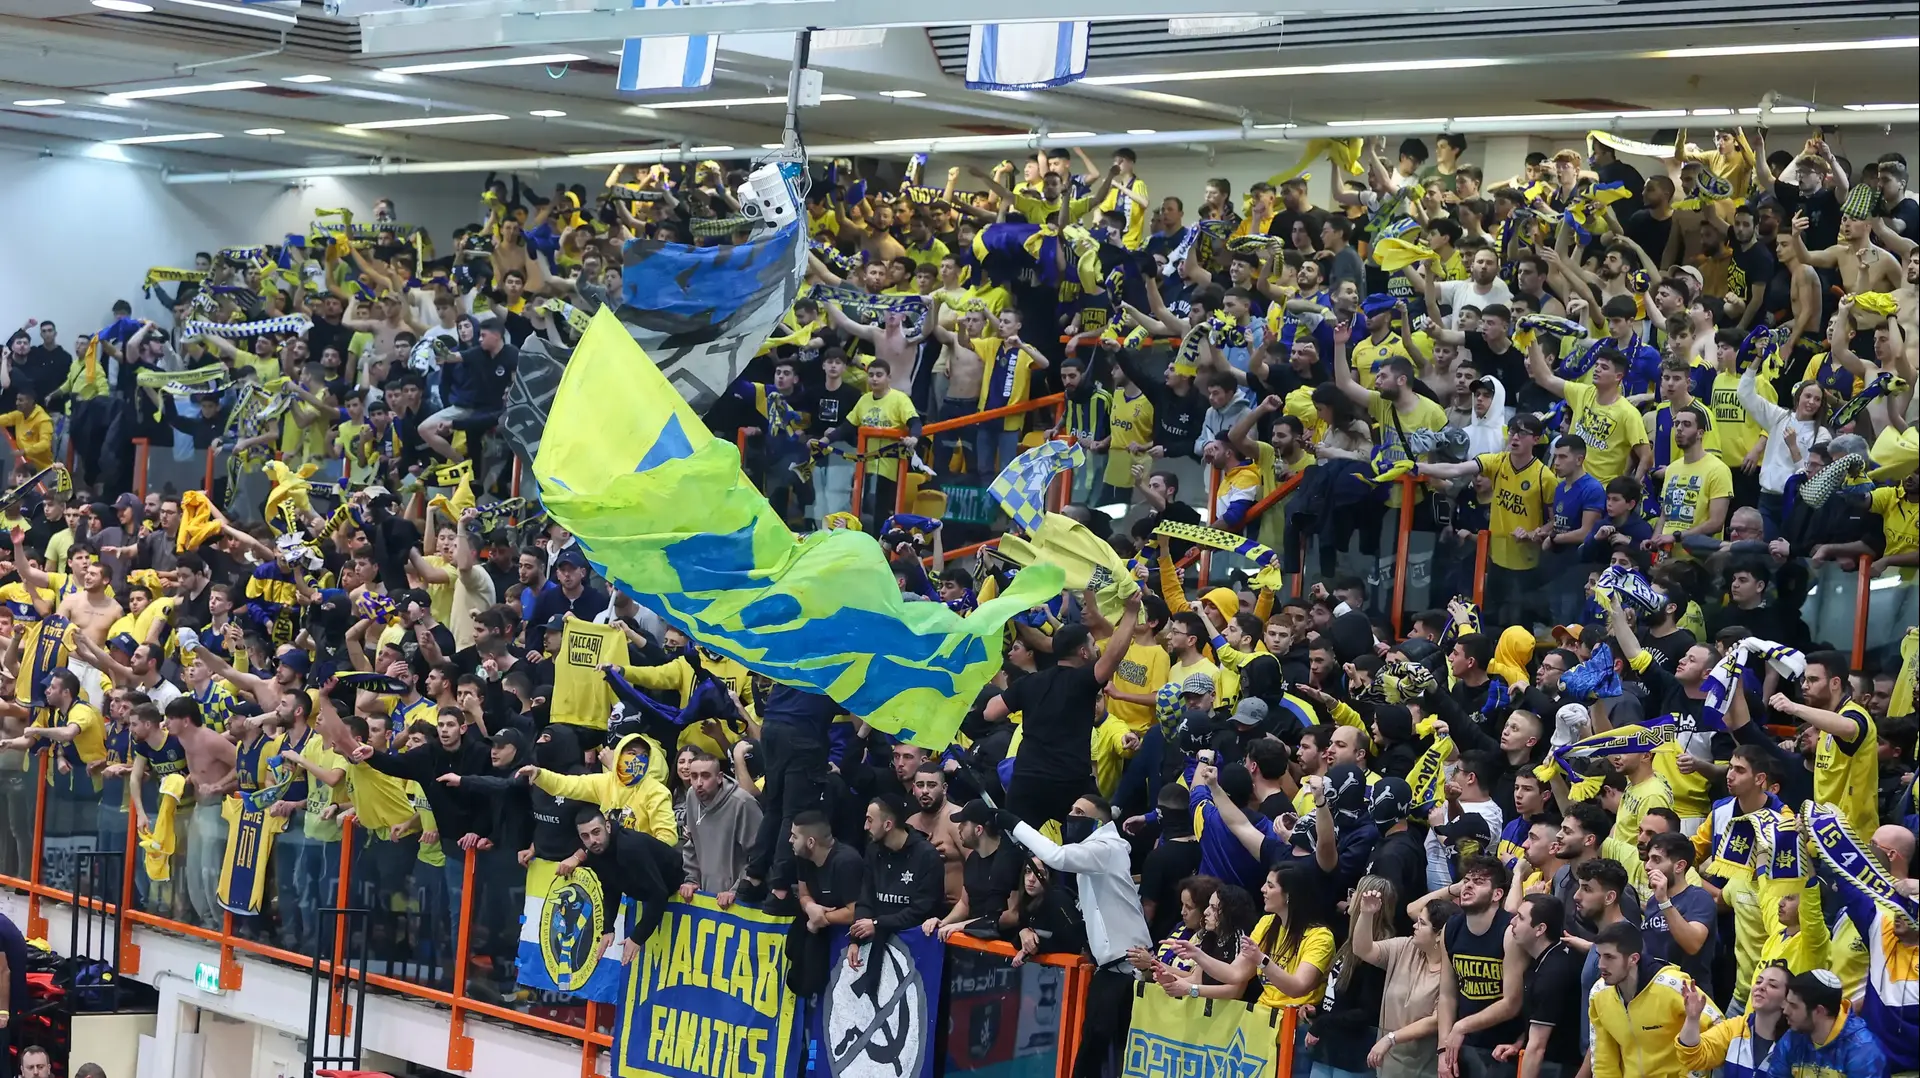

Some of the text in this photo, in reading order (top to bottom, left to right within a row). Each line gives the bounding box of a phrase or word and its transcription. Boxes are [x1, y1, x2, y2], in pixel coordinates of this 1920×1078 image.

[1714, 391, 1743, 409] MACCA
[1111, 417, 1133, 432] Jeep
[1070, 428, 1094, 440] avea
[156, 763, 178, 774] RAEL
[1840, 851, 1854, 867] 4
[876, 892, 910, 904] NATICS
[646, 1004, 769, 1078] FANATICS
